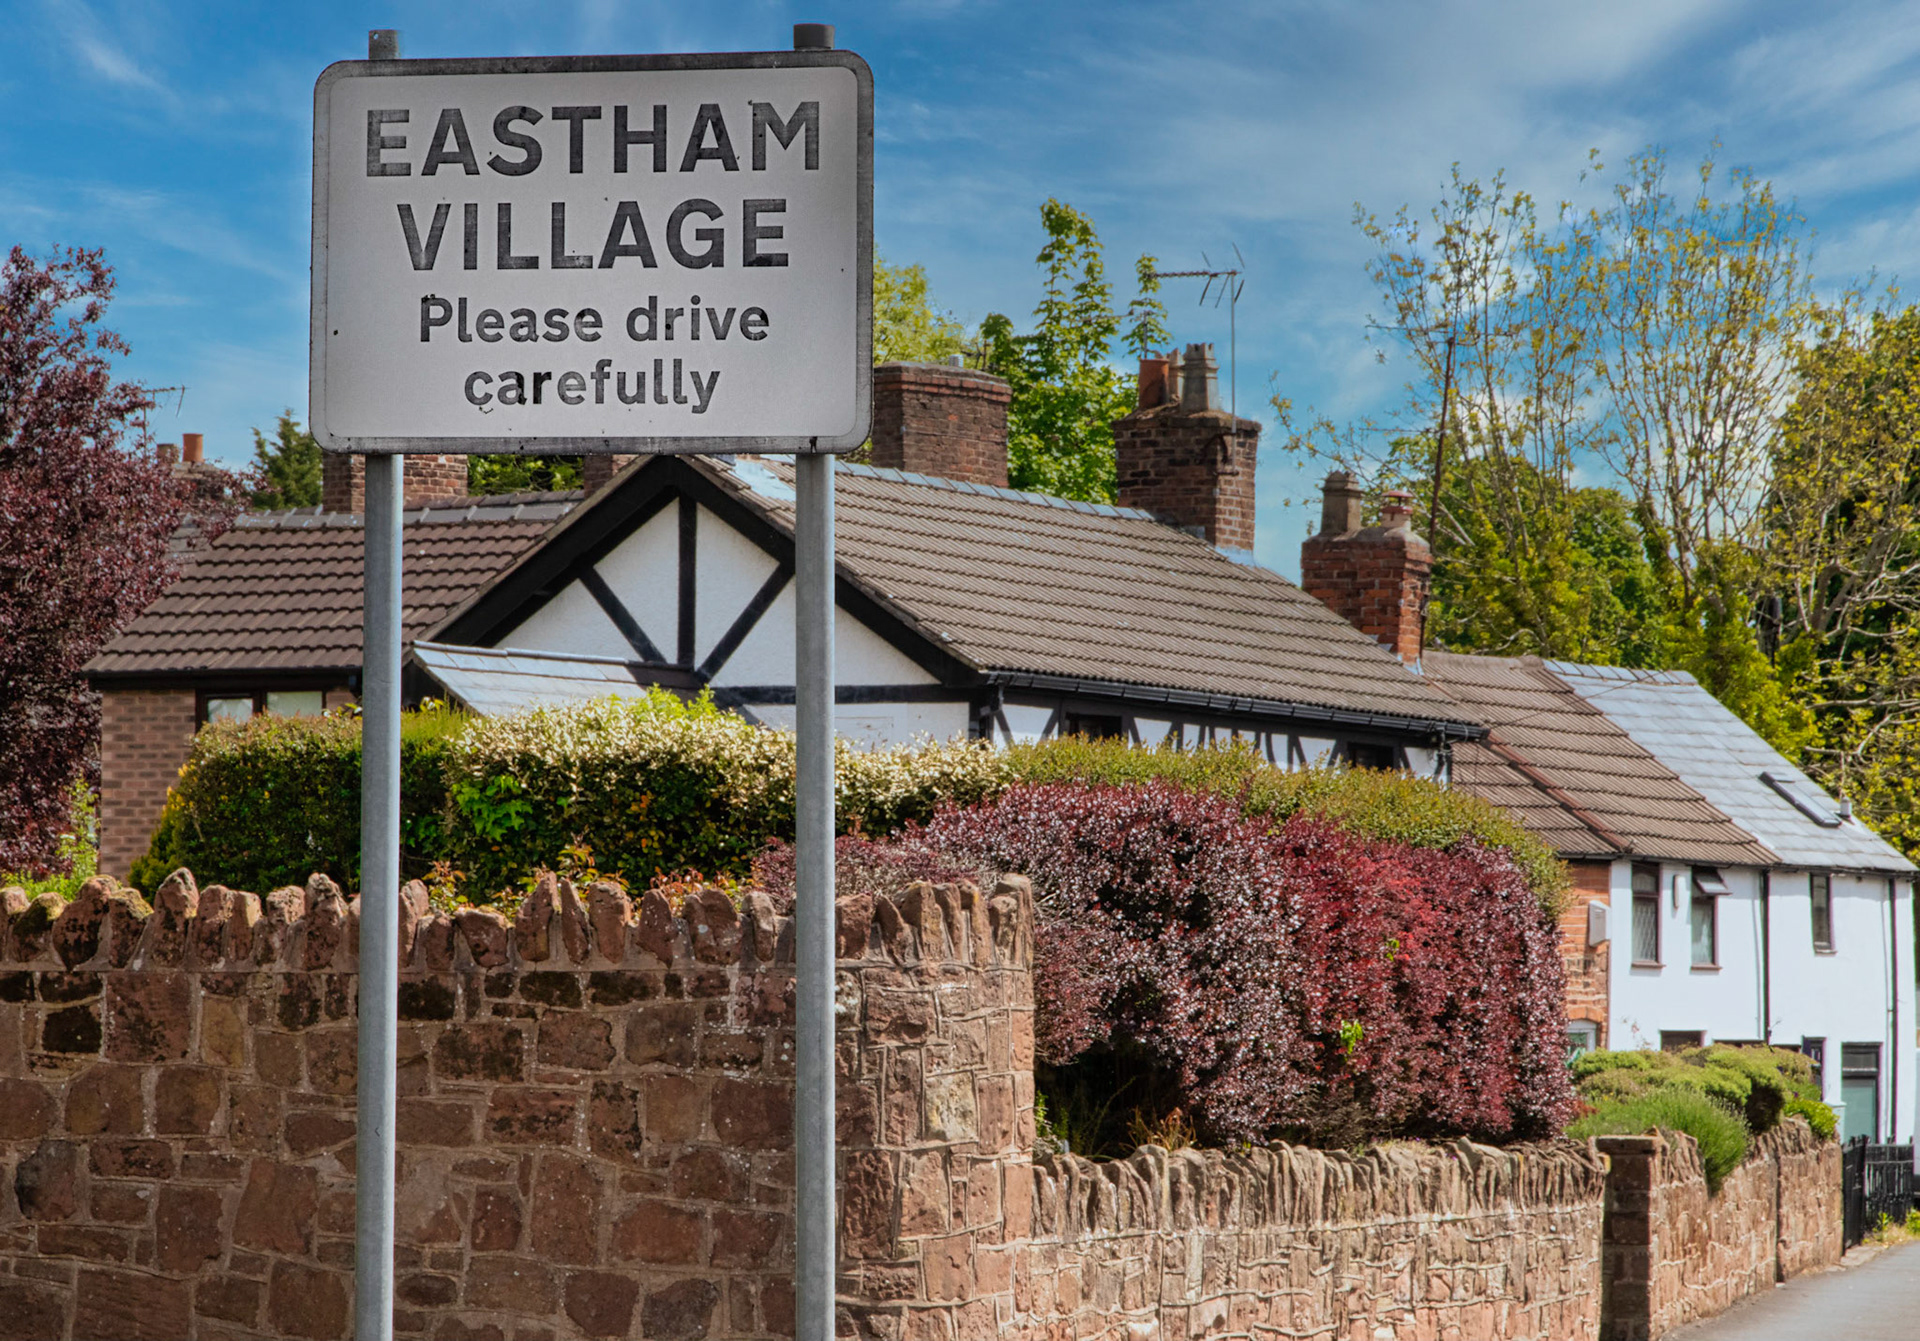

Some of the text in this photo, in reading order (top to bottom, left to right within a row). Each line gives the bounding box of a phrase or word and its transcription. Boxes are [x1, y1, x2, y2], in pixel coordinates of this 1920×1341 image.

[367, 101, 820, 178] EASTHAM
[397, 199, 789, 270] VILLAGE
[420, 294, 770, 343] Please drive
[465, 359, 720, 413] carefully
